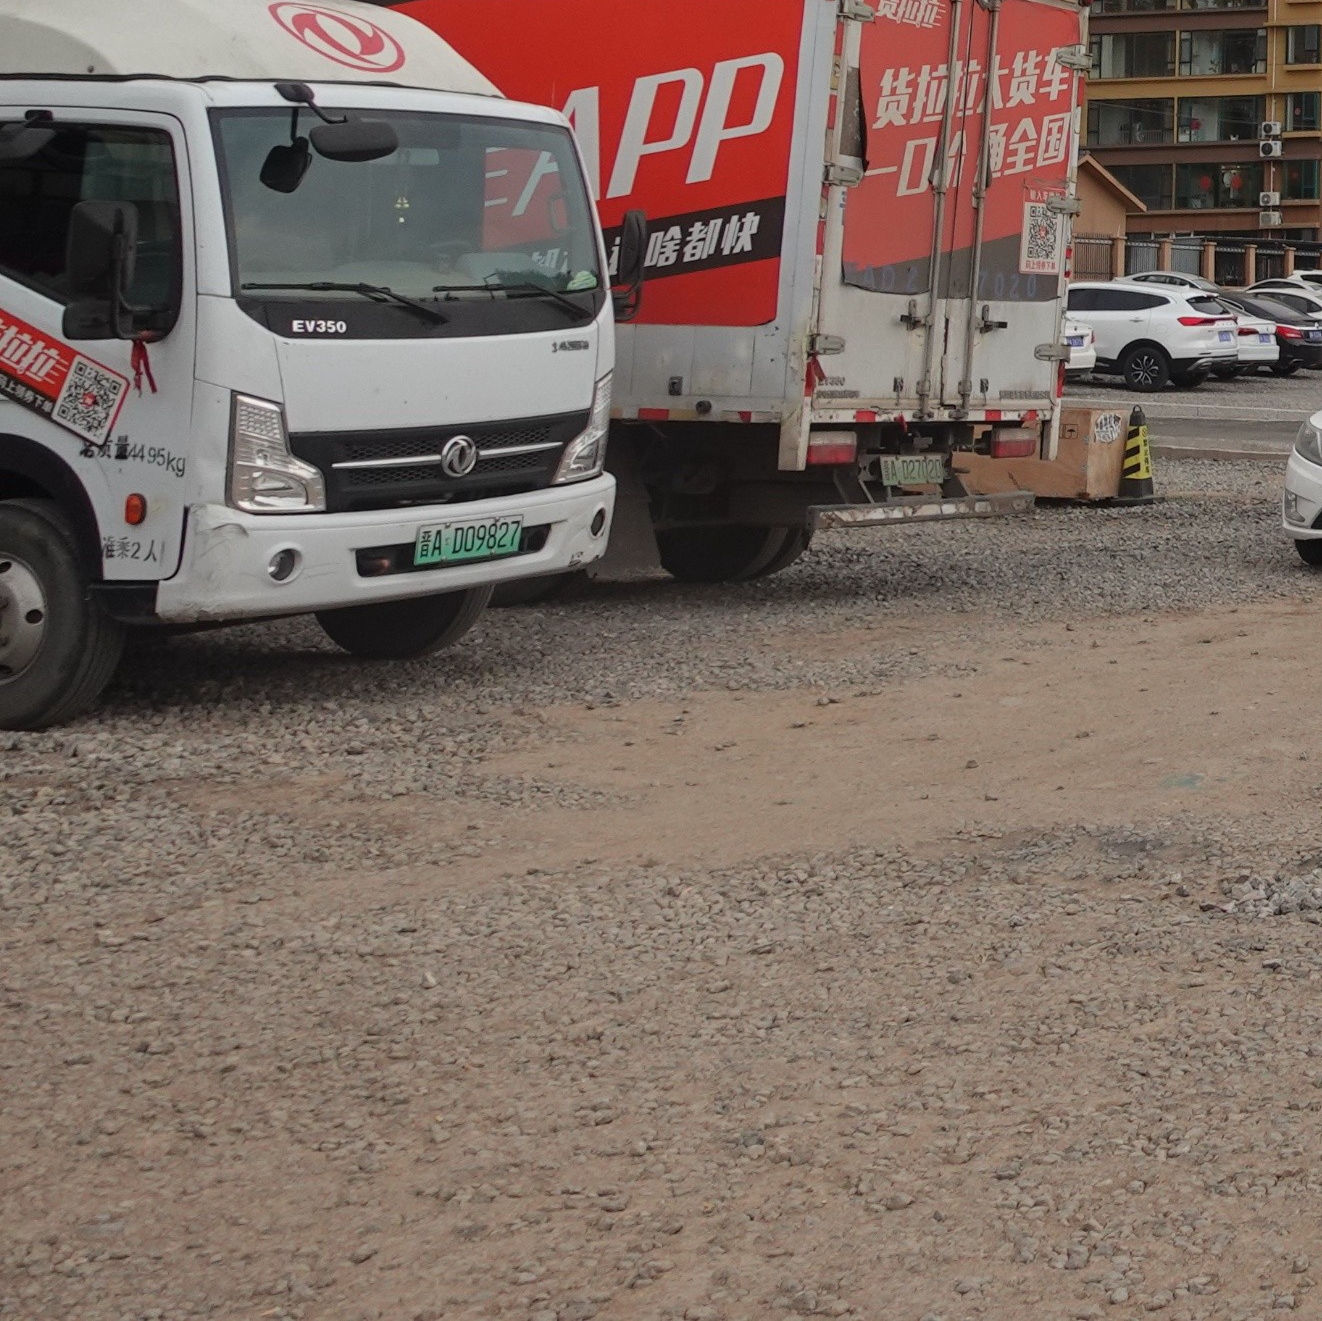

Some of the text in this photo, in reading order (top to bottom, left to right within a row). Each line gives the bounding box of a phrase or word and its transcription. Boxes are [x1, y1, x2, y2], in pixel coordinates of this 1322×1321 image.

[872, 47, 1070, 129] 货拉拉大货车
[0, 318, 61, 382] 拉拉
[292, 320, 347, 333] EV350
